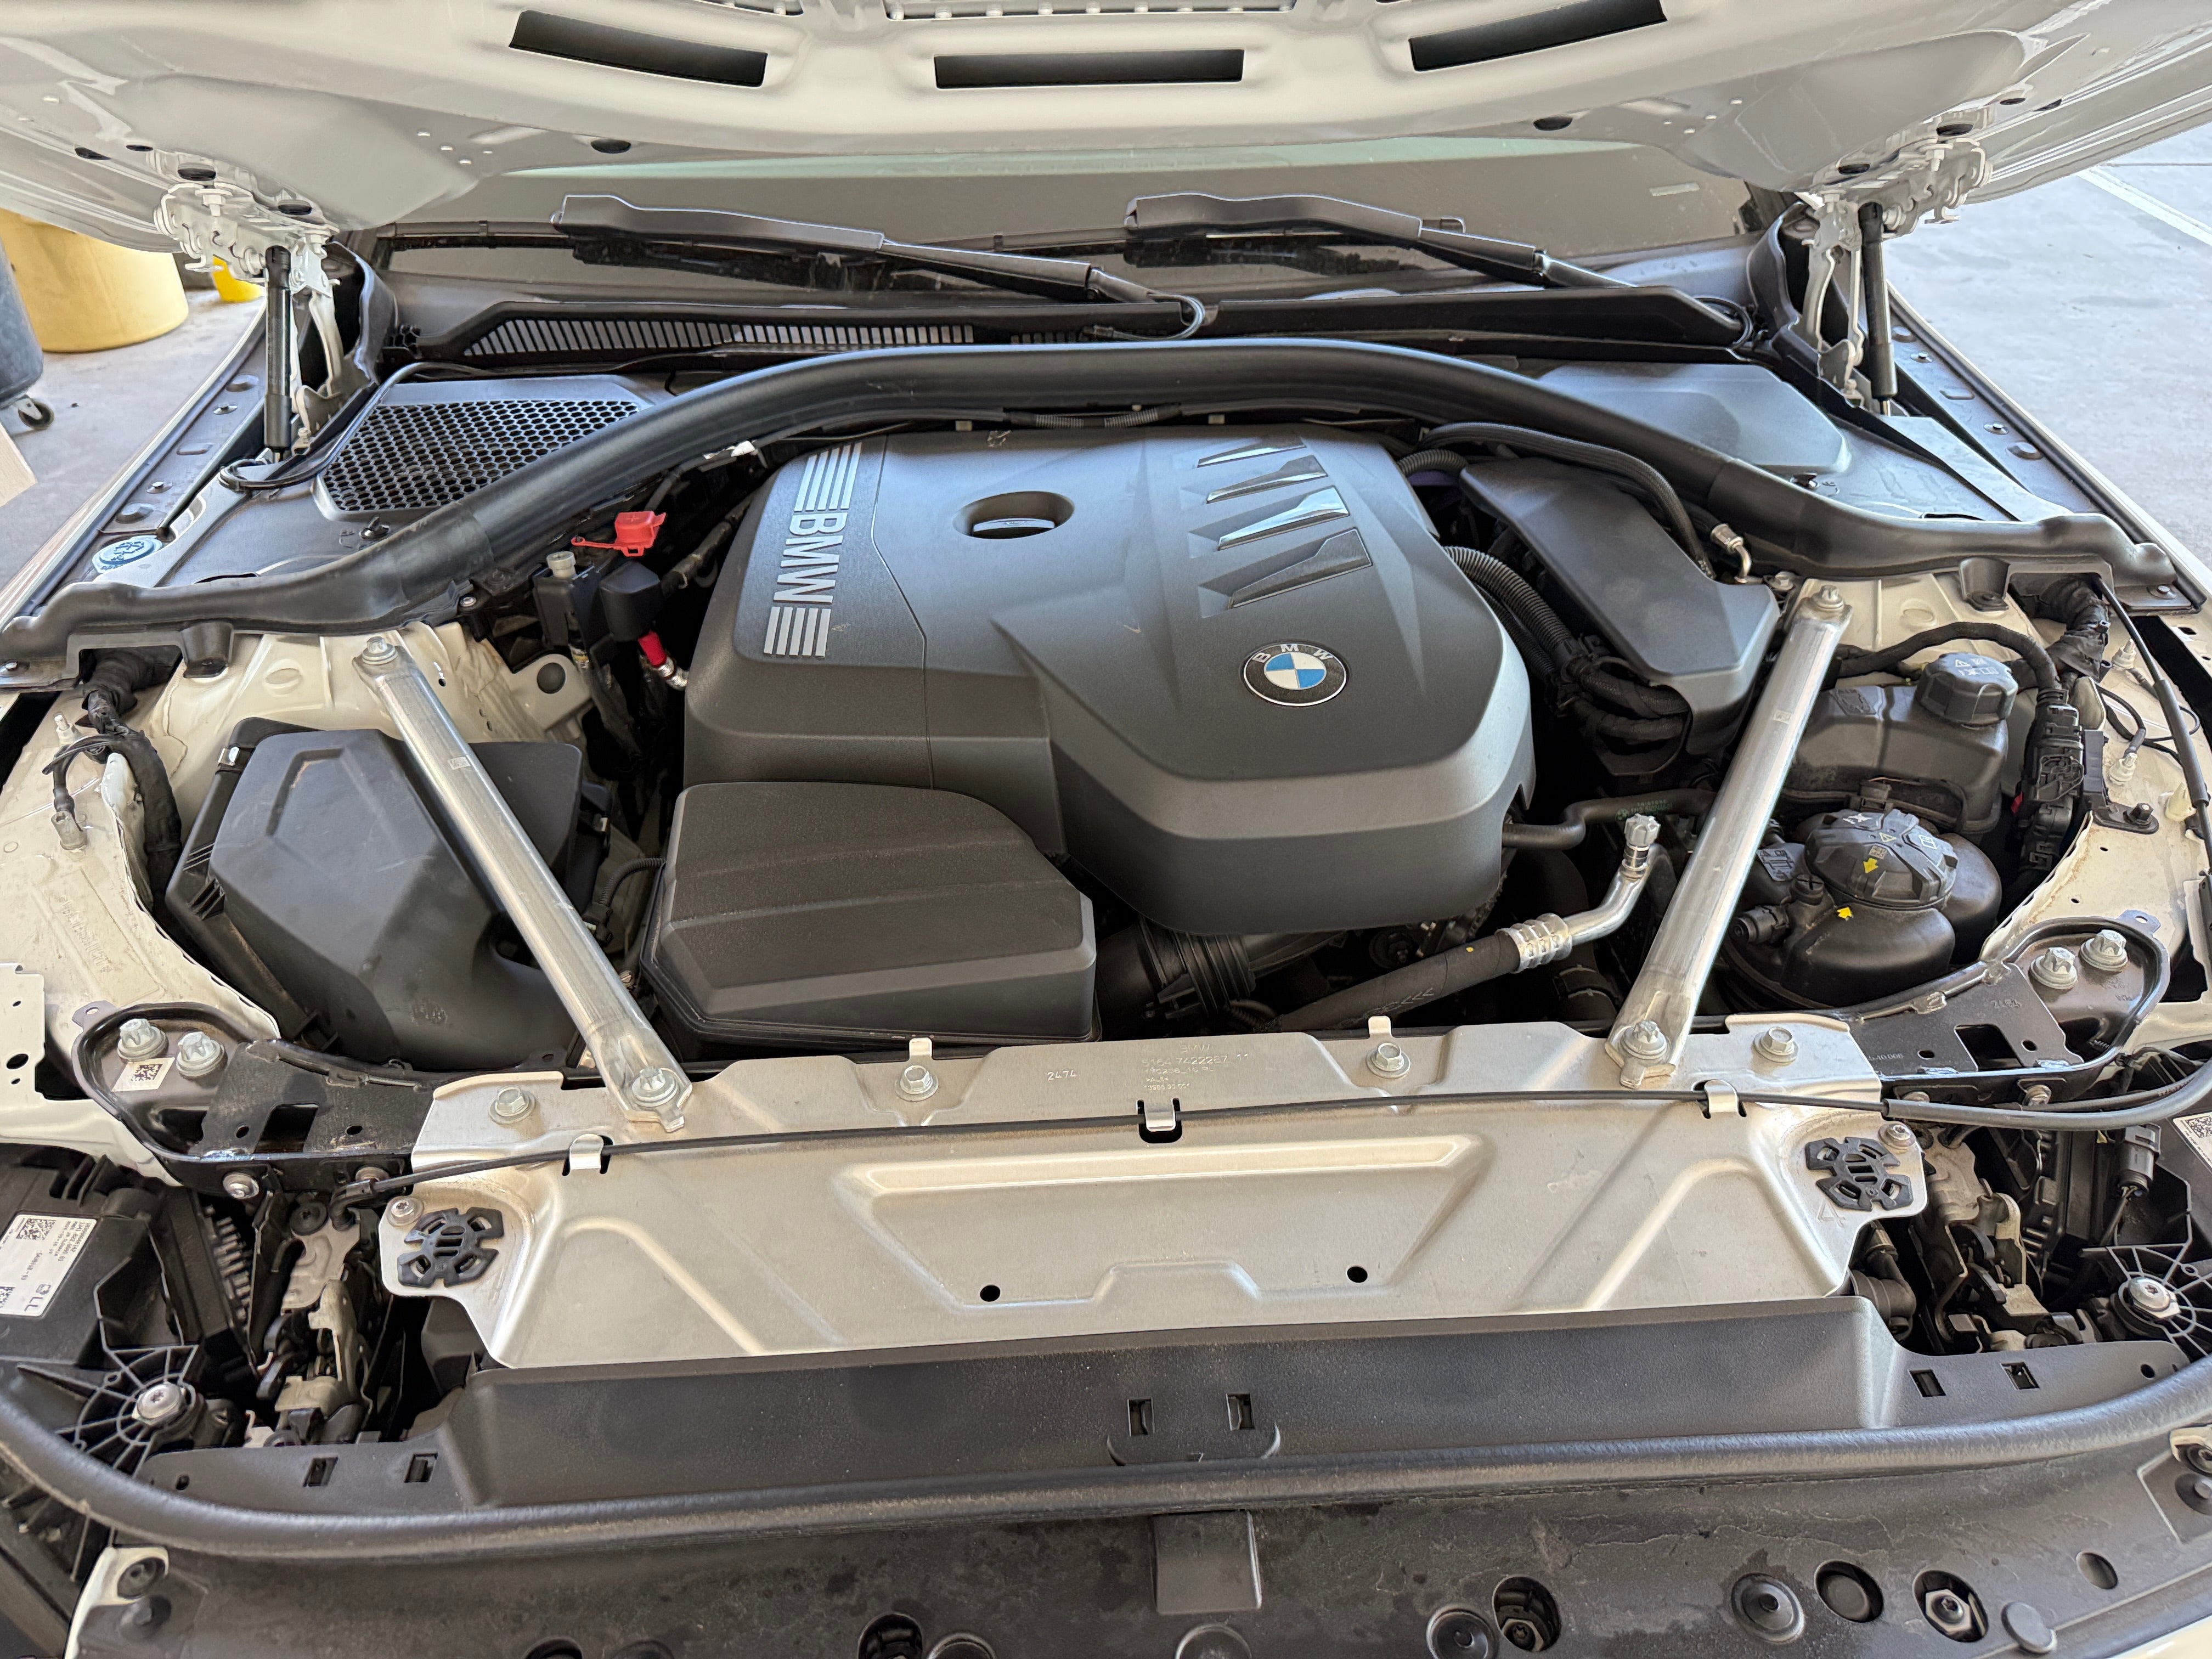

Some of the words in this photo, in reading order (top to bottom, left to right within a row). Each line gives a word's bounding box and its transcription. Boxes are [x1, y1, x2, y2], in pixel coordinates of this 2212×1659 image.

[774, 512, 848, 603] BMW
[1251, 643, 1334, 663] BMW
[1180, 1043, 1210, 1054] BMW
[1047, 1070, 1077, 1081] 2474
